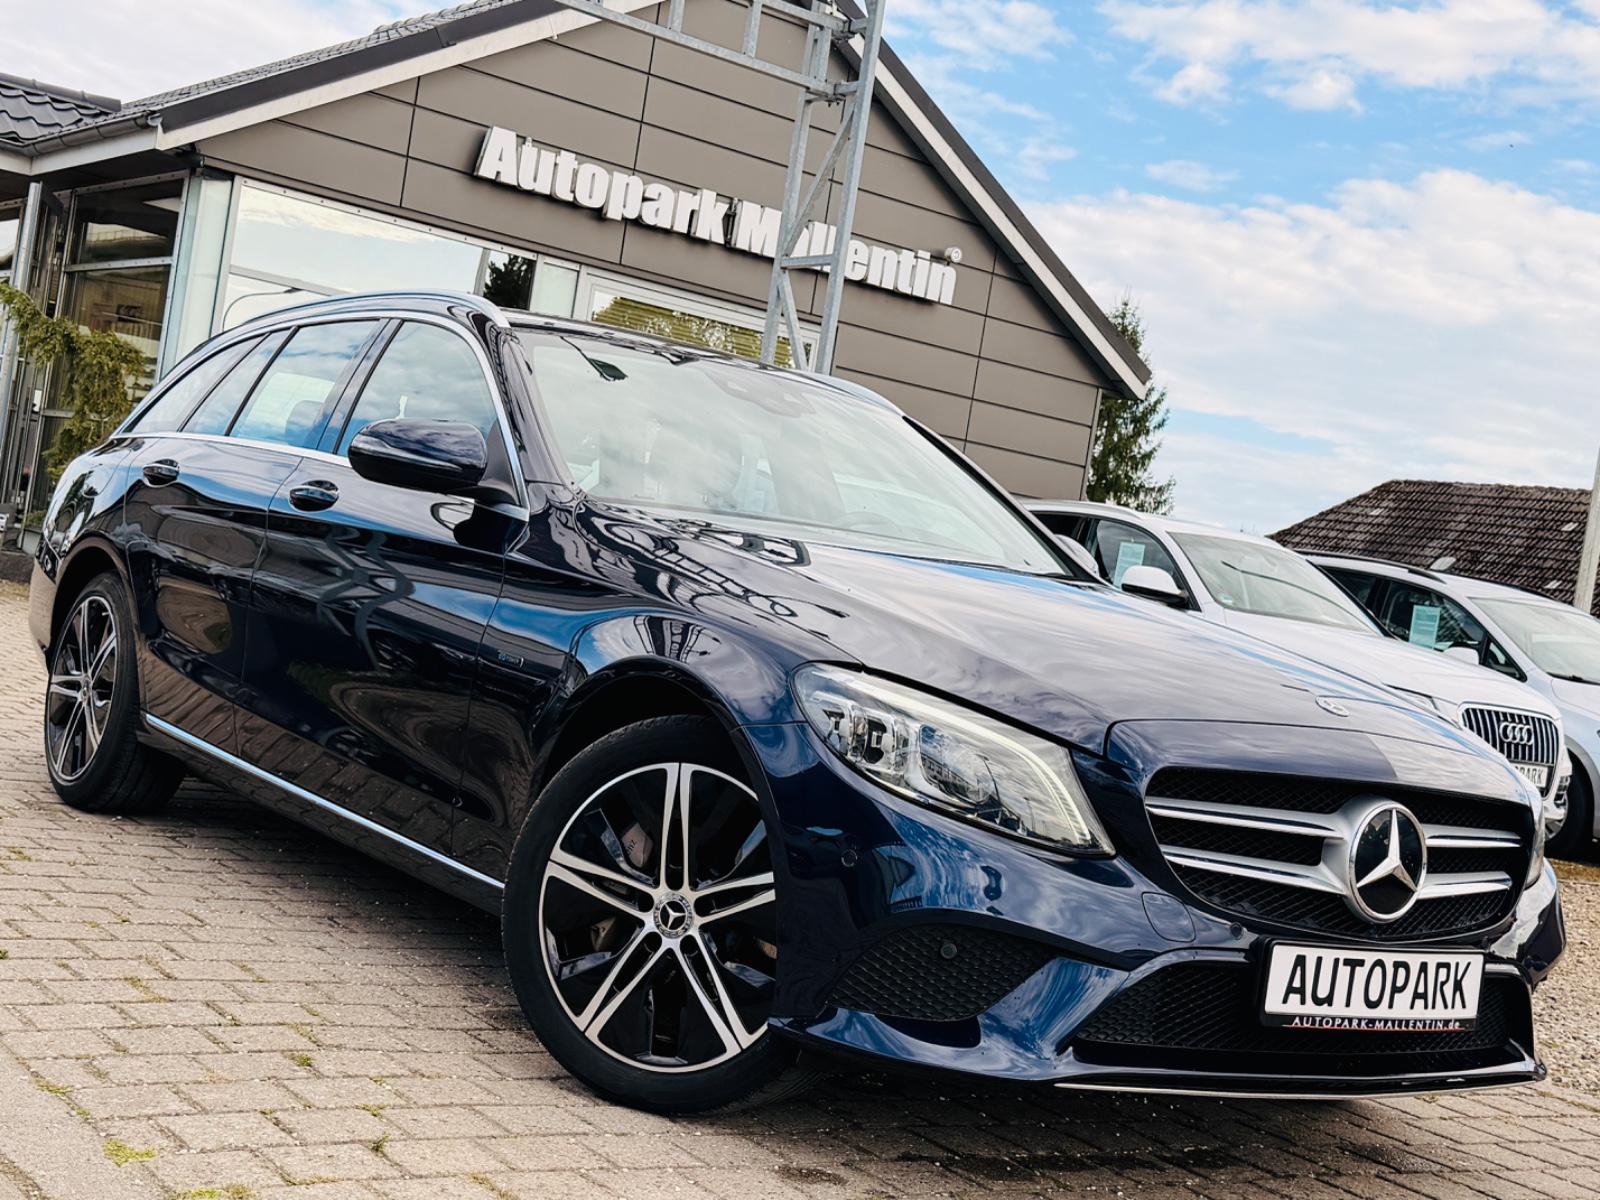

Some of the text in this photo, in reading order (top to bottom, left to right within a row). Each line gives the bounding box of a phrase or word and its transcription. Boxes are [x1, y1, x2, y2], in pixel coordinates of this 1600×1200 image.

[475, 125, 730, 245] Autopark
[1282, 953, 1471, 1010] AUTOPARK
[1292, 1015, 1460, 1030] AUTOPARK-MALLENTIN.de
